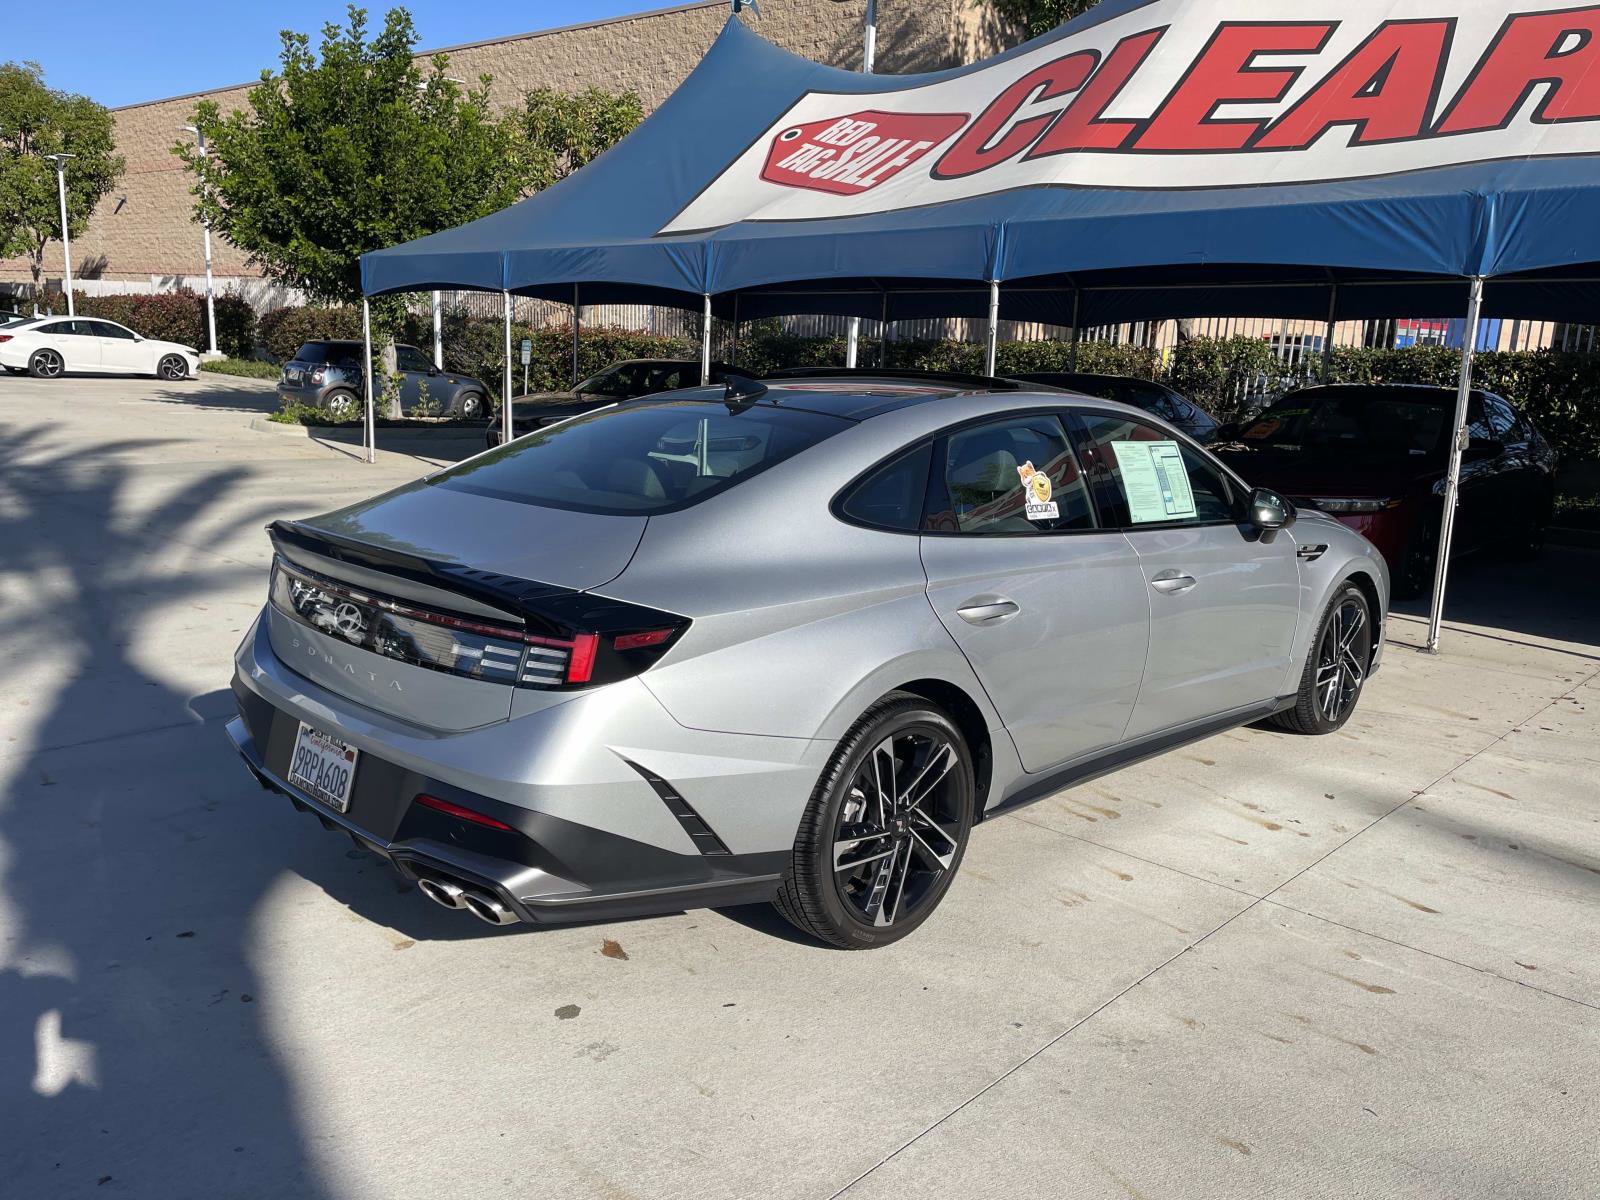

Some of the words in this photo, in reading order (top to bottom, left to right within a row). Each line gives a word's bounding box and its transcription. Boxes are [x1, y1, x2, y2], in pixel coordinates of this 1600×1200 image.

[930, 4, 1600, 181] CLEAR
[775, 142, 837, 173] TAG
[812, 117, 878, 147] RED
[808, 135, 934, 188] SALE
[292, 638, 402, 691] SONATA
[294, 745, 349, 798] 9RPA608
